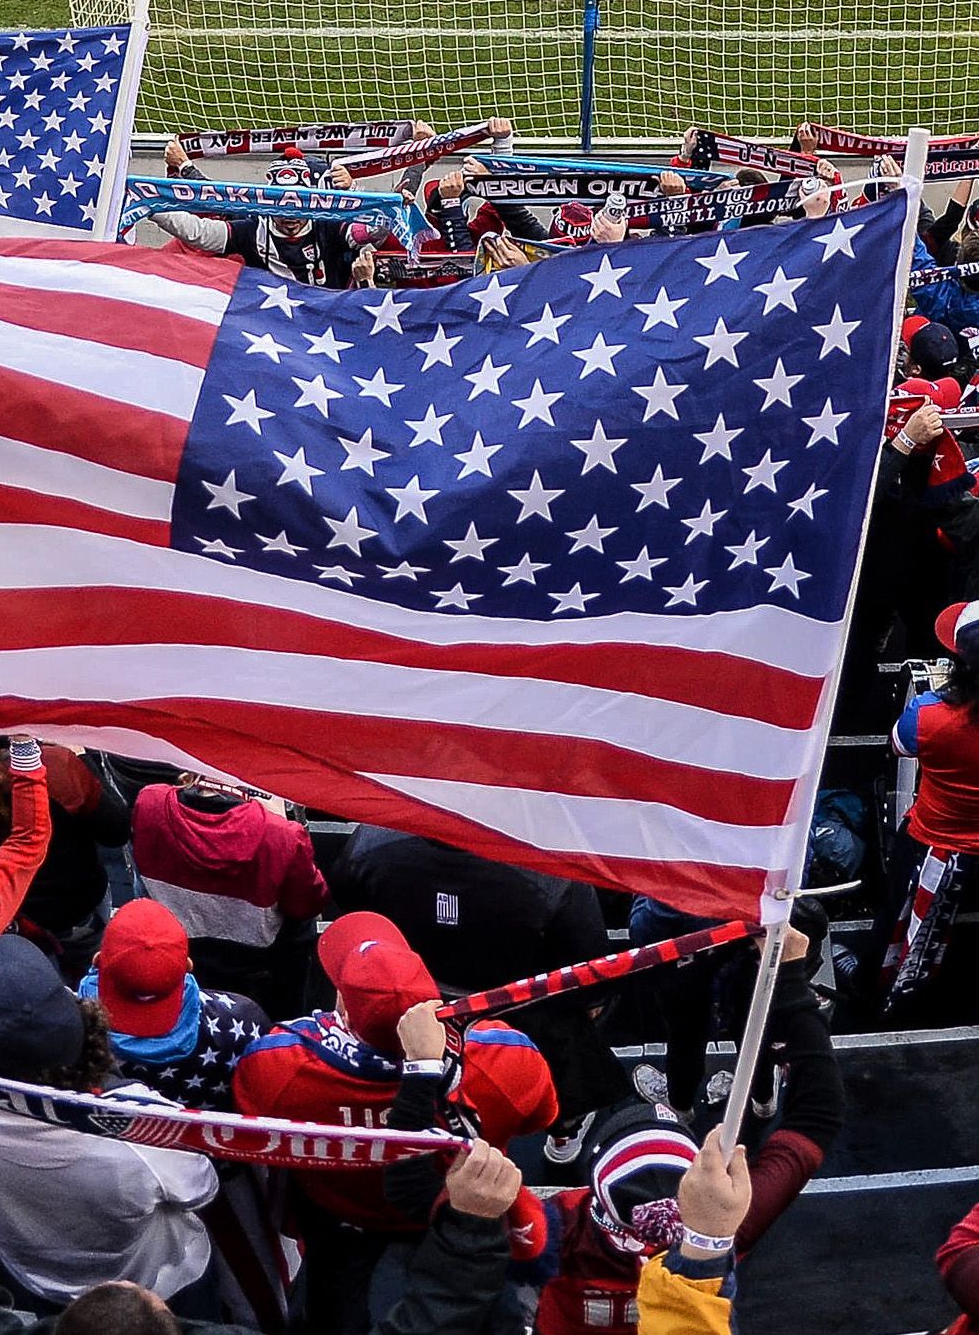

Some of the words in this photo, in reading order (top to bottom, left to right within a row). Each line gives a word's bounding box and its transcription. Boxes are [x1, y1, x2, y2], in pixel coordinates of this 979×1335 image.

[209, 132, 245, 148] SAY
[252, 130, 309, 144] NEVER
[315, 124, 397, 140] OUTLAWS
[181, 137, 202, 153] DI
[172, 183, 362, 210] OAKLAND
[466, 178, 578, 196] MERICAN
[588, 179, 664, 198] OUTLA
[691, 193, 727, 208] YOU
[728, 187, 753, 203] GO
[661, 206, 717, 227] WE'LL
